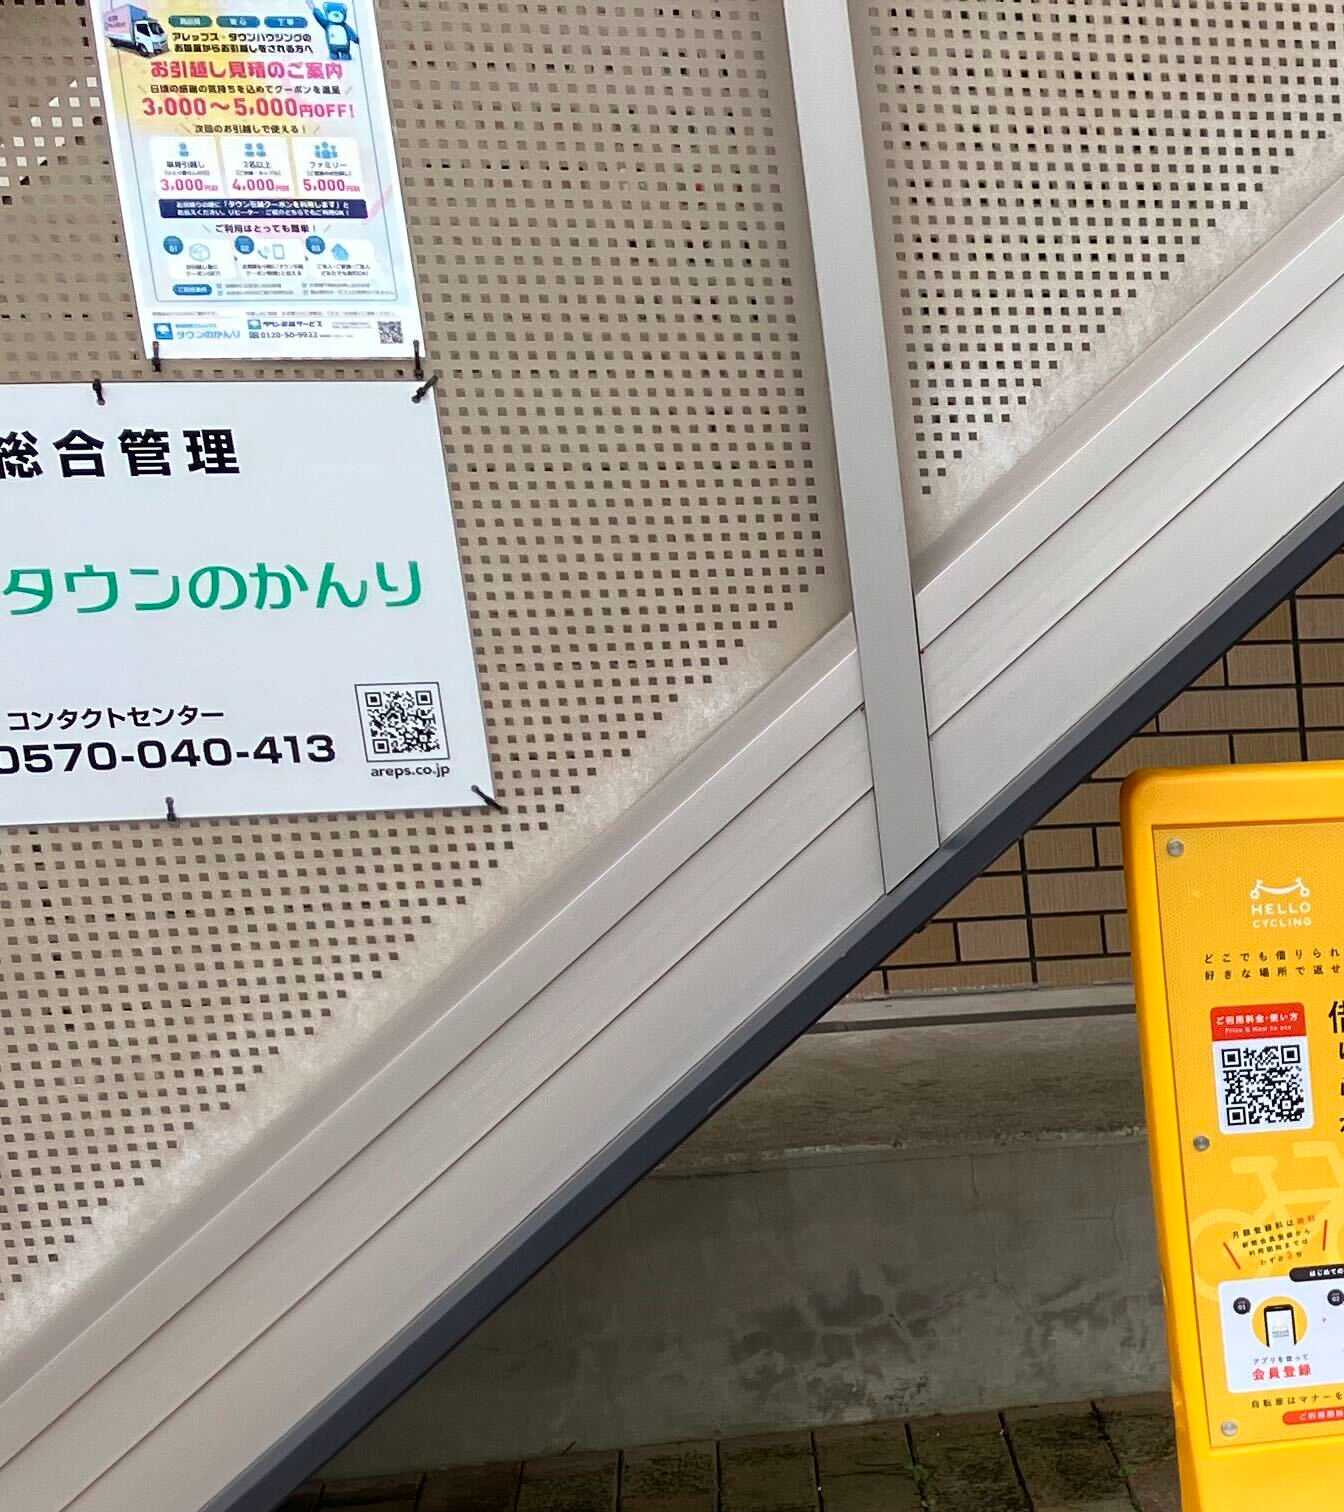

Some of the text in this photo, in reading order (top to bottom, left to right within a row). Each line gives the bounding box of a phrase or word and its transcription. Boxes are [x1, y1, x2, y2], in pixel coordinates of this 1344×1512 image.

[0, 428, 240, 479] 総合管理
[2, 560, 422, 615] タウンのかんり
[8, 705, 224, 732] コンタクトセンター
[0, 734, 336, 775] 0570-040-413
[370, 763, 450, 778] areps.co.jp
[1251, 902, 1312, 916] HELLO
[1252, 916, 1313, 929] CYCLING
[1252, 1363, 1312, 1381] 会員登録
